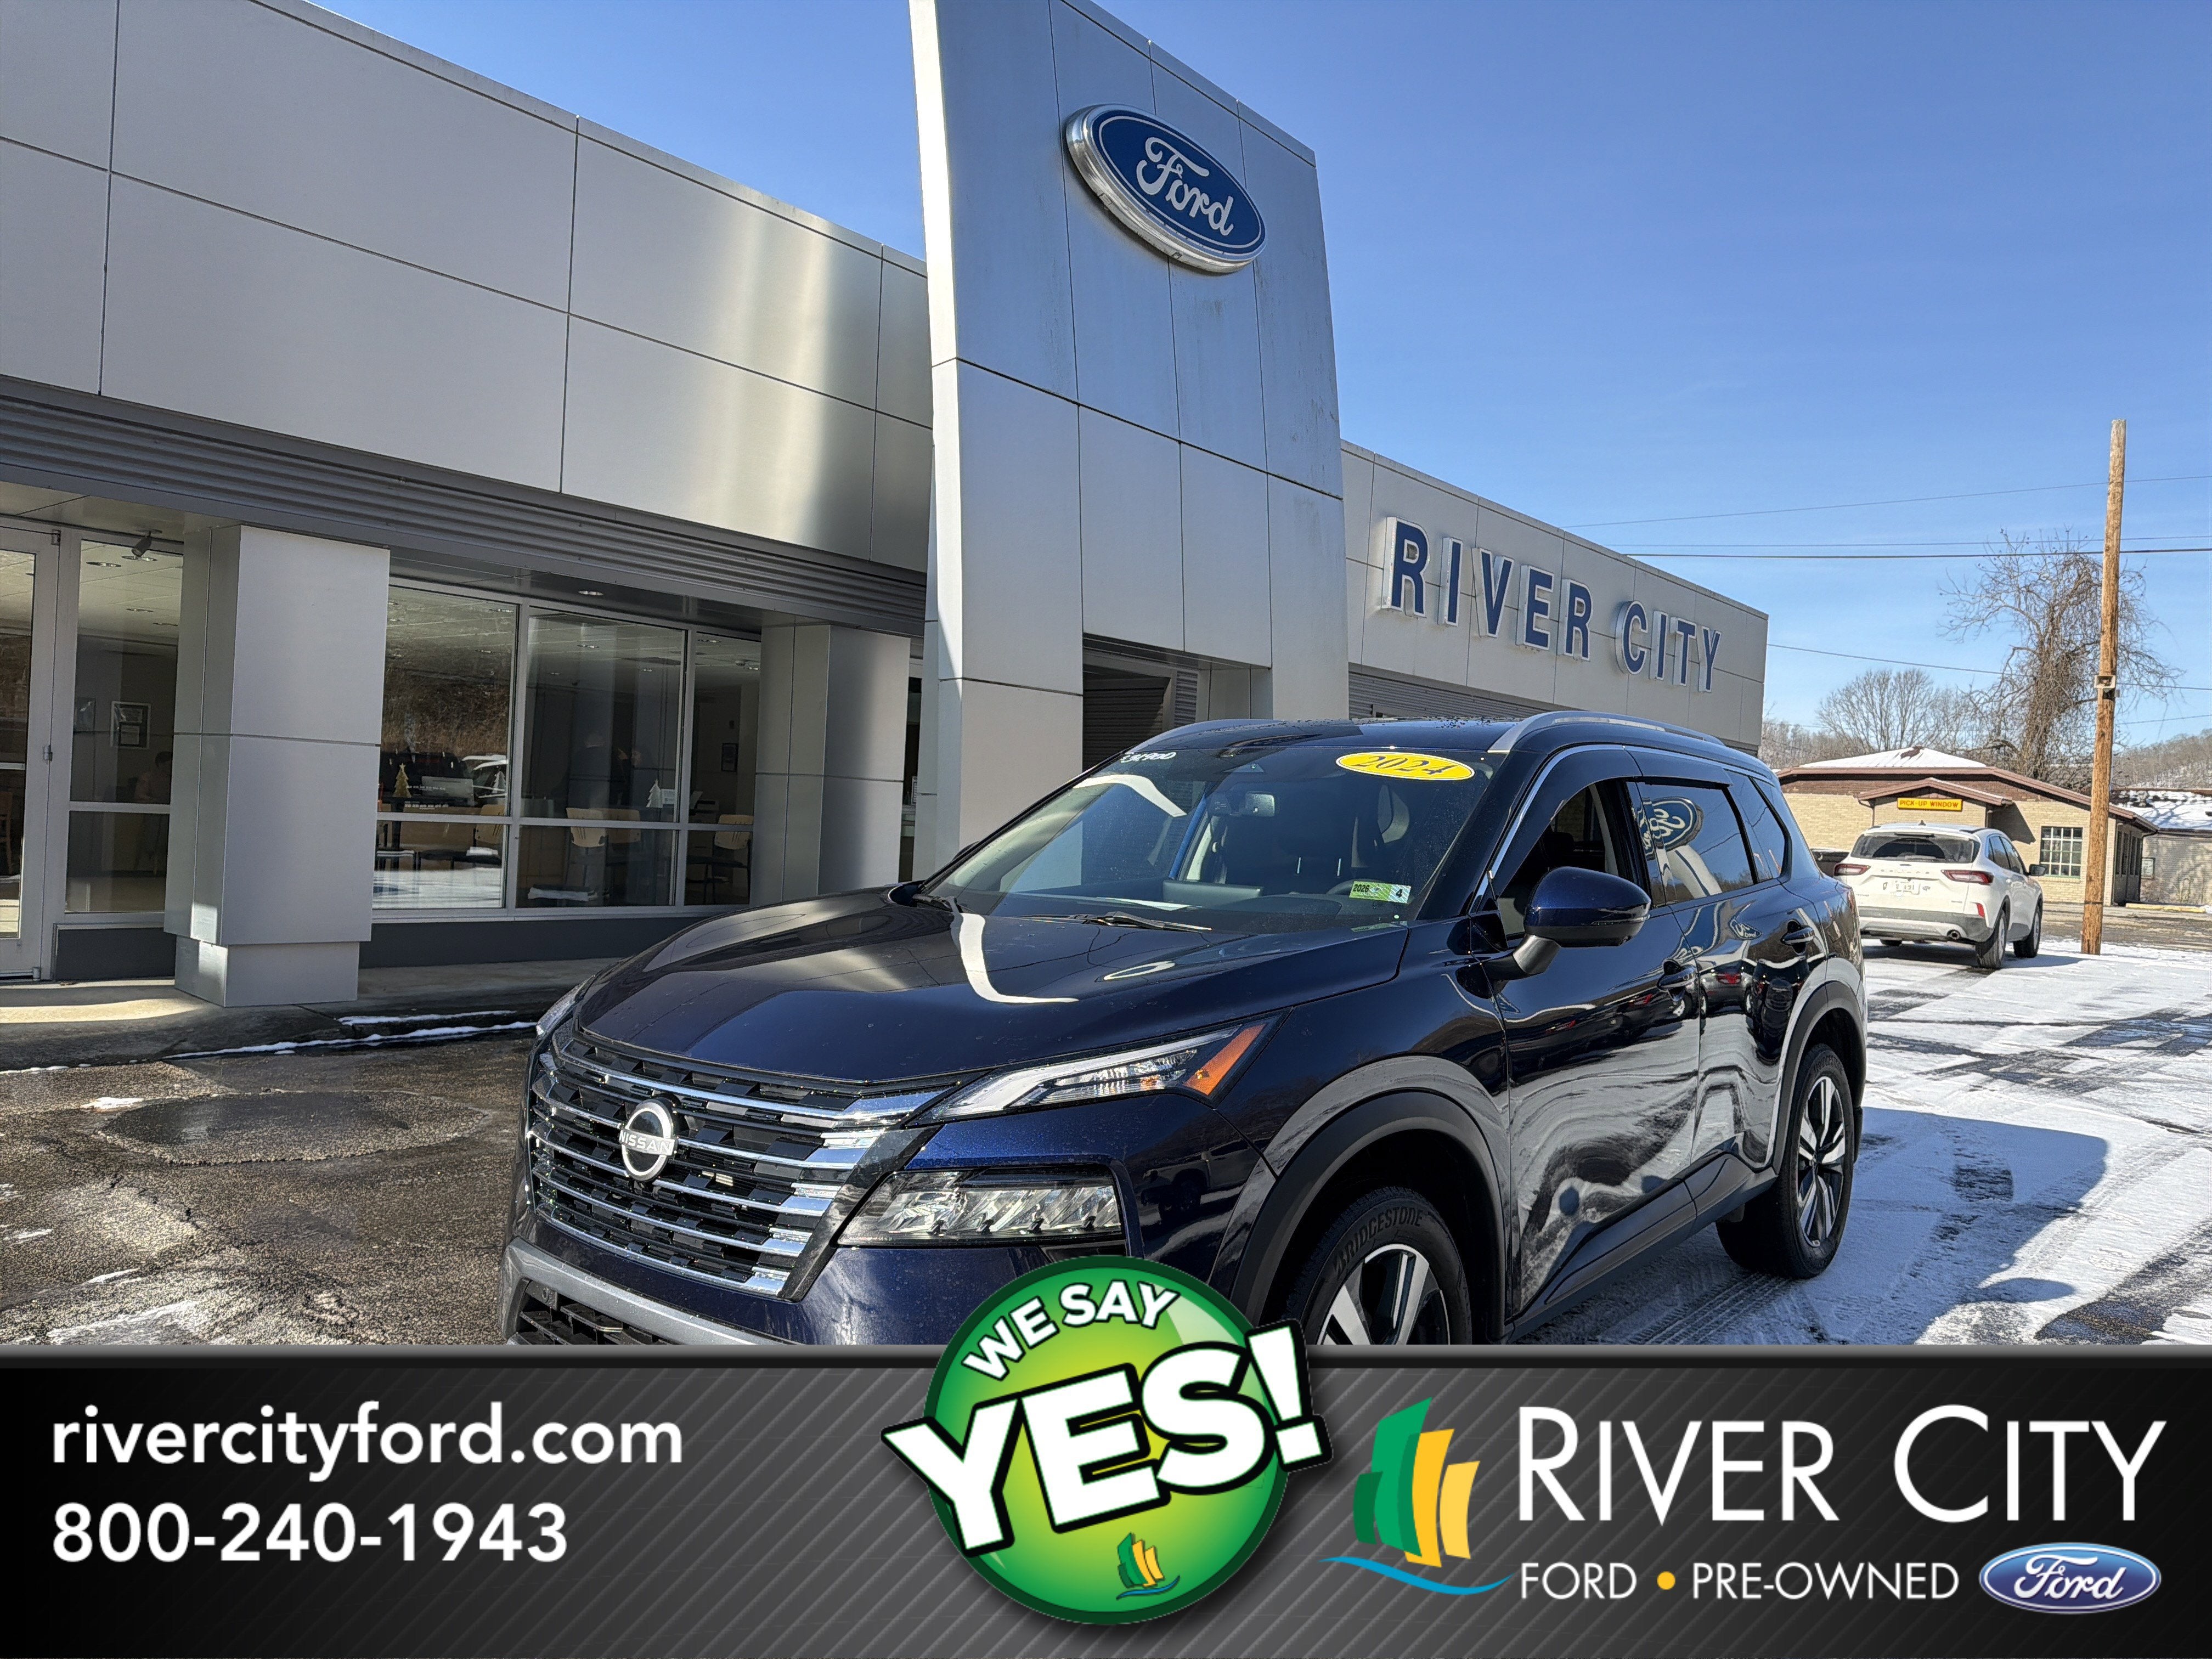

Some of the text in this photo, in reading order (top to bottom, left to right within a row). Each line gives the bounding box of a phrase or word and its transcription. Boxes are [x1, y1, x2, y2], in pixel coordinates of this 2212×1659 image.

[1136, 137, 1234, 236] Ford
[1381, 517, 1722, 692] RIVER CITY
[1352, 755, 1459, 775] 2024
[1353, 884, 1370, 893] 2026
[1395, 889, 1403, 898] 4
[619, 1130, 672, 1155] NISSAN
[1334, 1206, 1424, 1279] BRIDGESTONE
